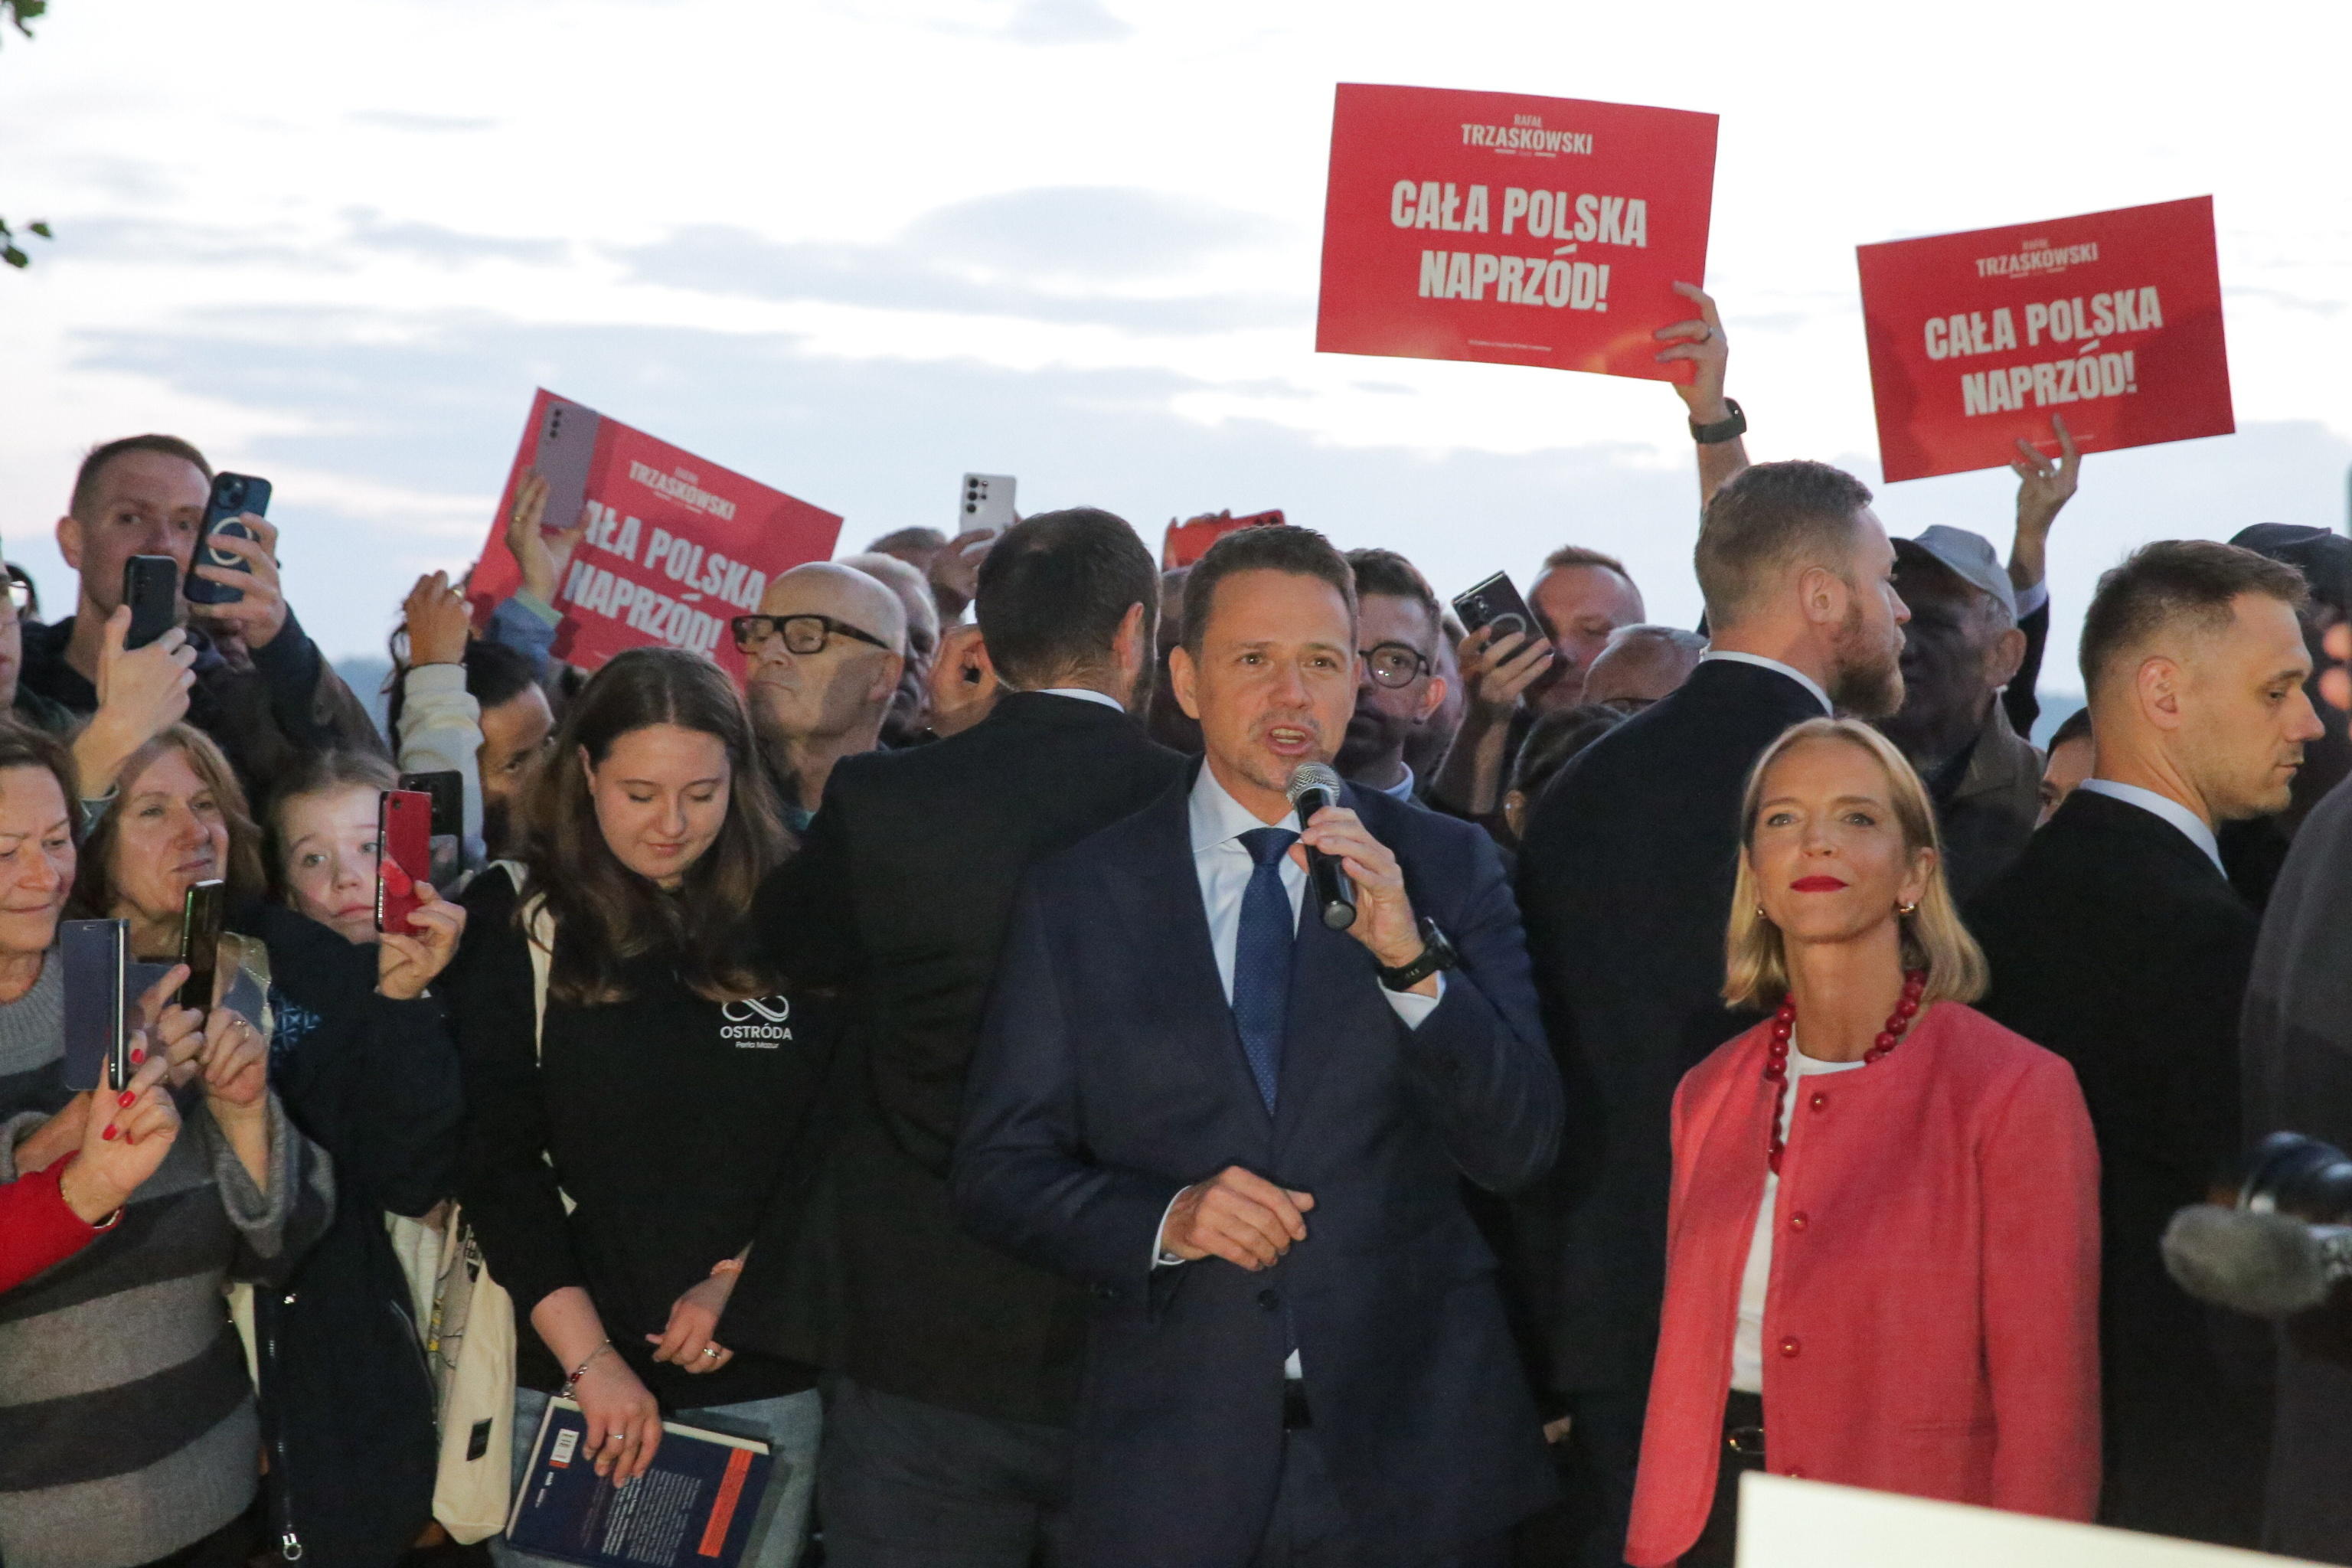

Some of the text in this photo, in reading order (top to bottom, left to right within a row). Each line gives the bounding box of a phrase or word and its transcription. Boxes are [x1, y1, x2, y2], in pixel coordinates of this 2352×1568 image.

[1461, 123, 1592, 155] TRZASKOWSKI
[1390, 180, 1647, 248] CAŁA POLSKA
[1418, 243, 1610, 312] NAPRZÓD!
[1976, 241, 2099, 278] TRZASKOWSKI
[1924, 286, 2164, 361] CAŁA POLSKA
[1961, 339, 2138, 417] NAPRZÓD!
[629, 460, 736, 521] TRZASKOWSKI
[585, 499, 766, 613] AŁA POLSKA
[564, 559, 724, 662] NAPRZÓD!
[720, 1023, 793, 1040] OSTRÓDA
